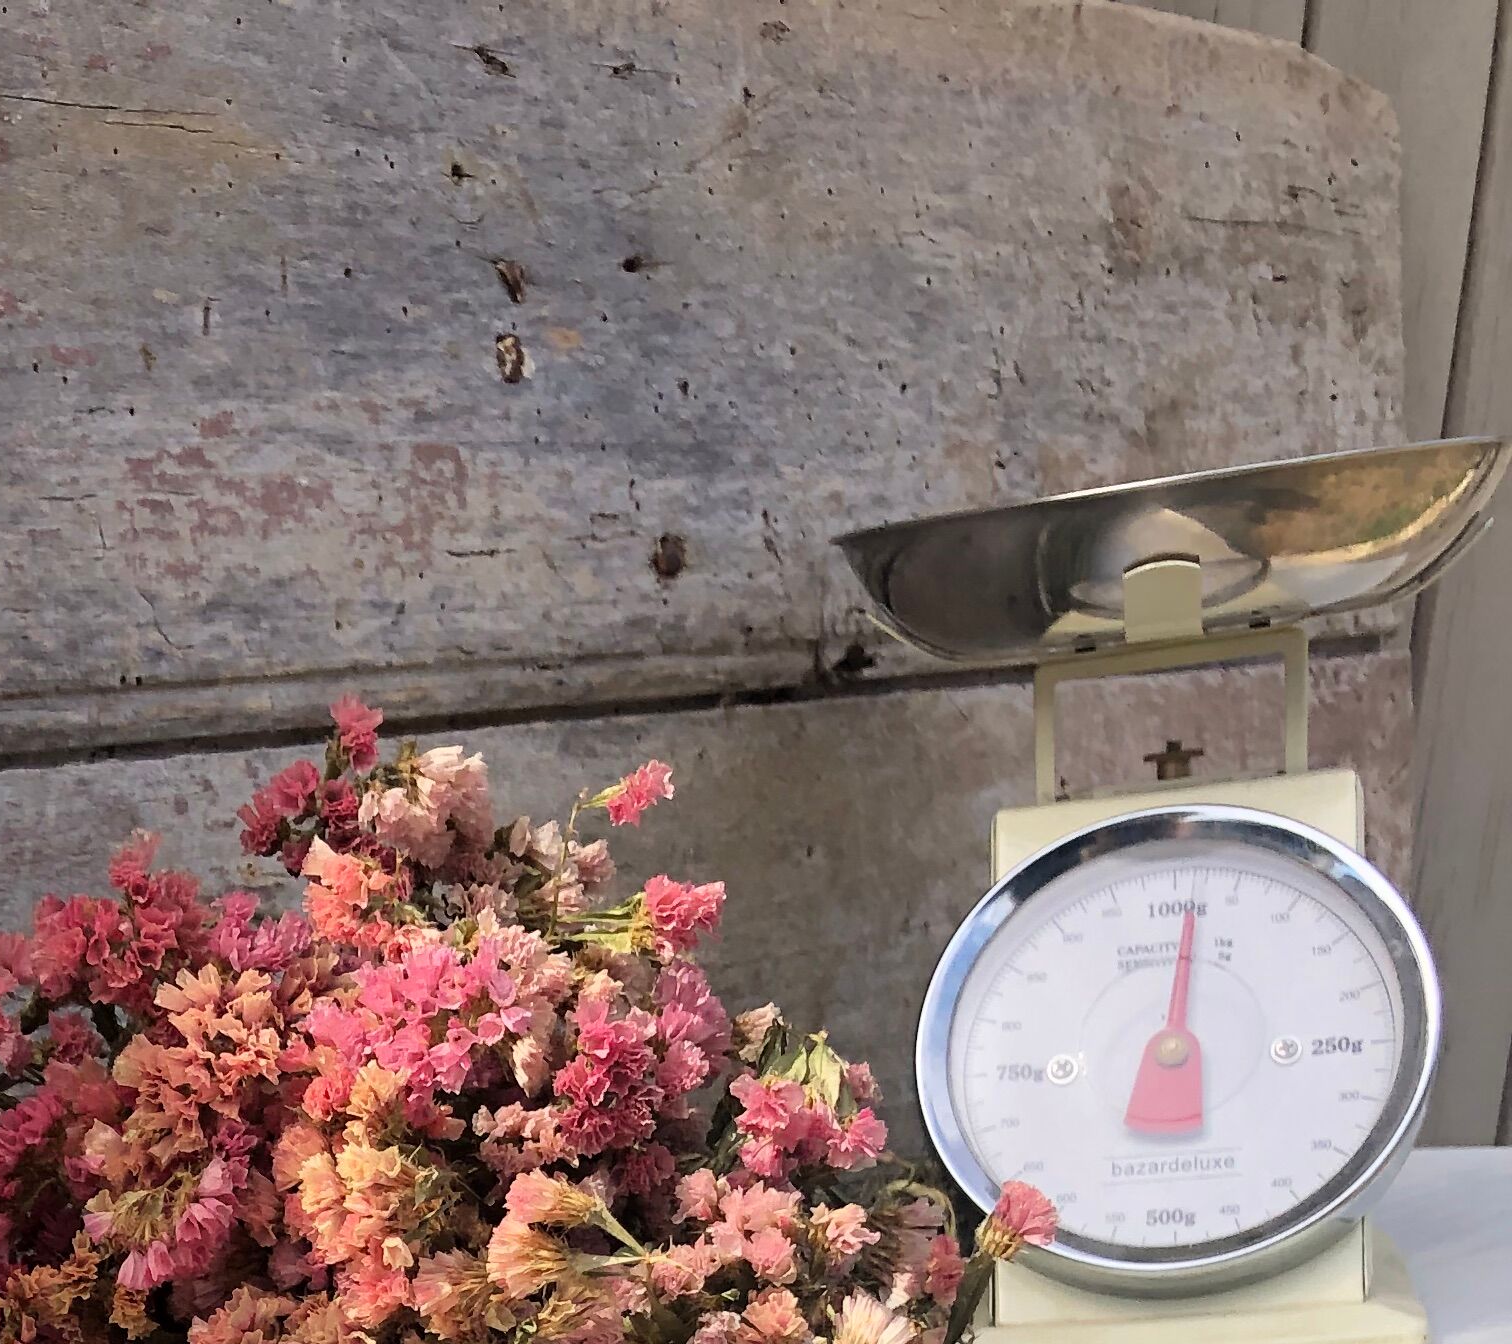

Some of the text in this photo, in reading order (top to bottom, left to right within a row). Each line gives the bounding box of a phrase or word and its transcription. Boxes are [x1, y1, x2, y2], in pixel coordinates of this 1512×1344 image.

[1148, 900, 1208, 919] 1000g
[1311, 1036, 1364, 1055] 250g
[996, 1064, 1045, 1083] 750g
[1110, 1155, 1236, 1177] bazardeluxe
[1145, 1208, 1196, 1227] 500g
